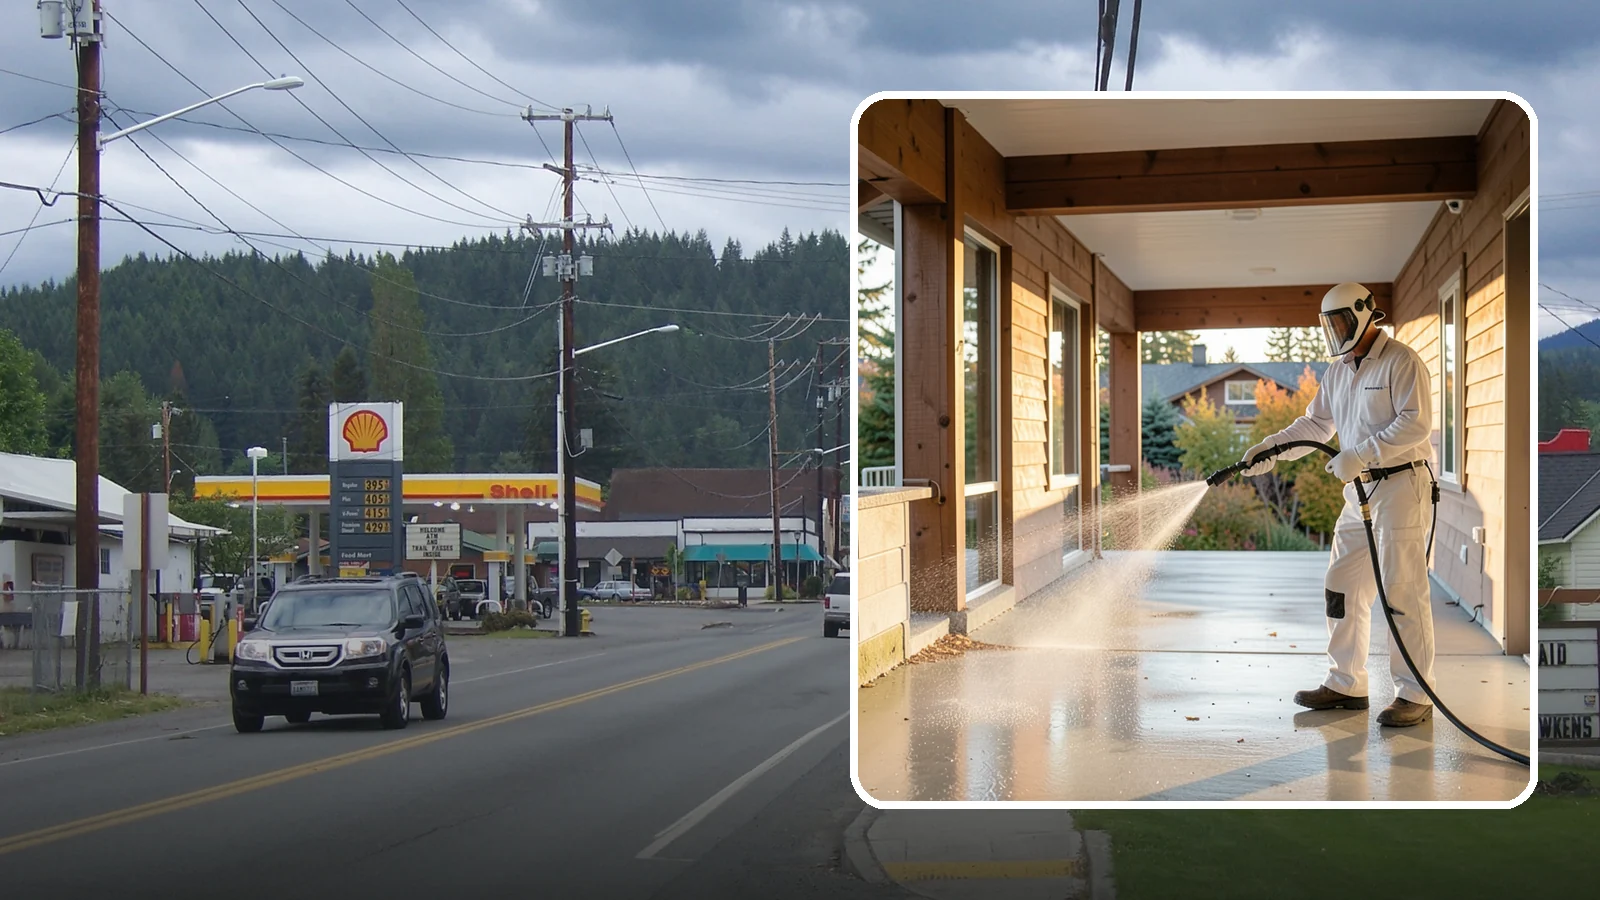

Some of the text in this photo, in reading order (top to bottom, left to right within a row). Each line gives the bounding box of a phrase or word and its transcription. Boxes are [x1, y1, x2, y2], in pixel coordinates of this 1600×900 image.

[366, 480, 383, 490] 395
[490, 484, 548, 499] Shell
[366, 494, 383, 503] 405
[366, 508, 383, 518] 415
[366, 522, 383, 533] 429
[1538, 642, 1567, 666] AID
